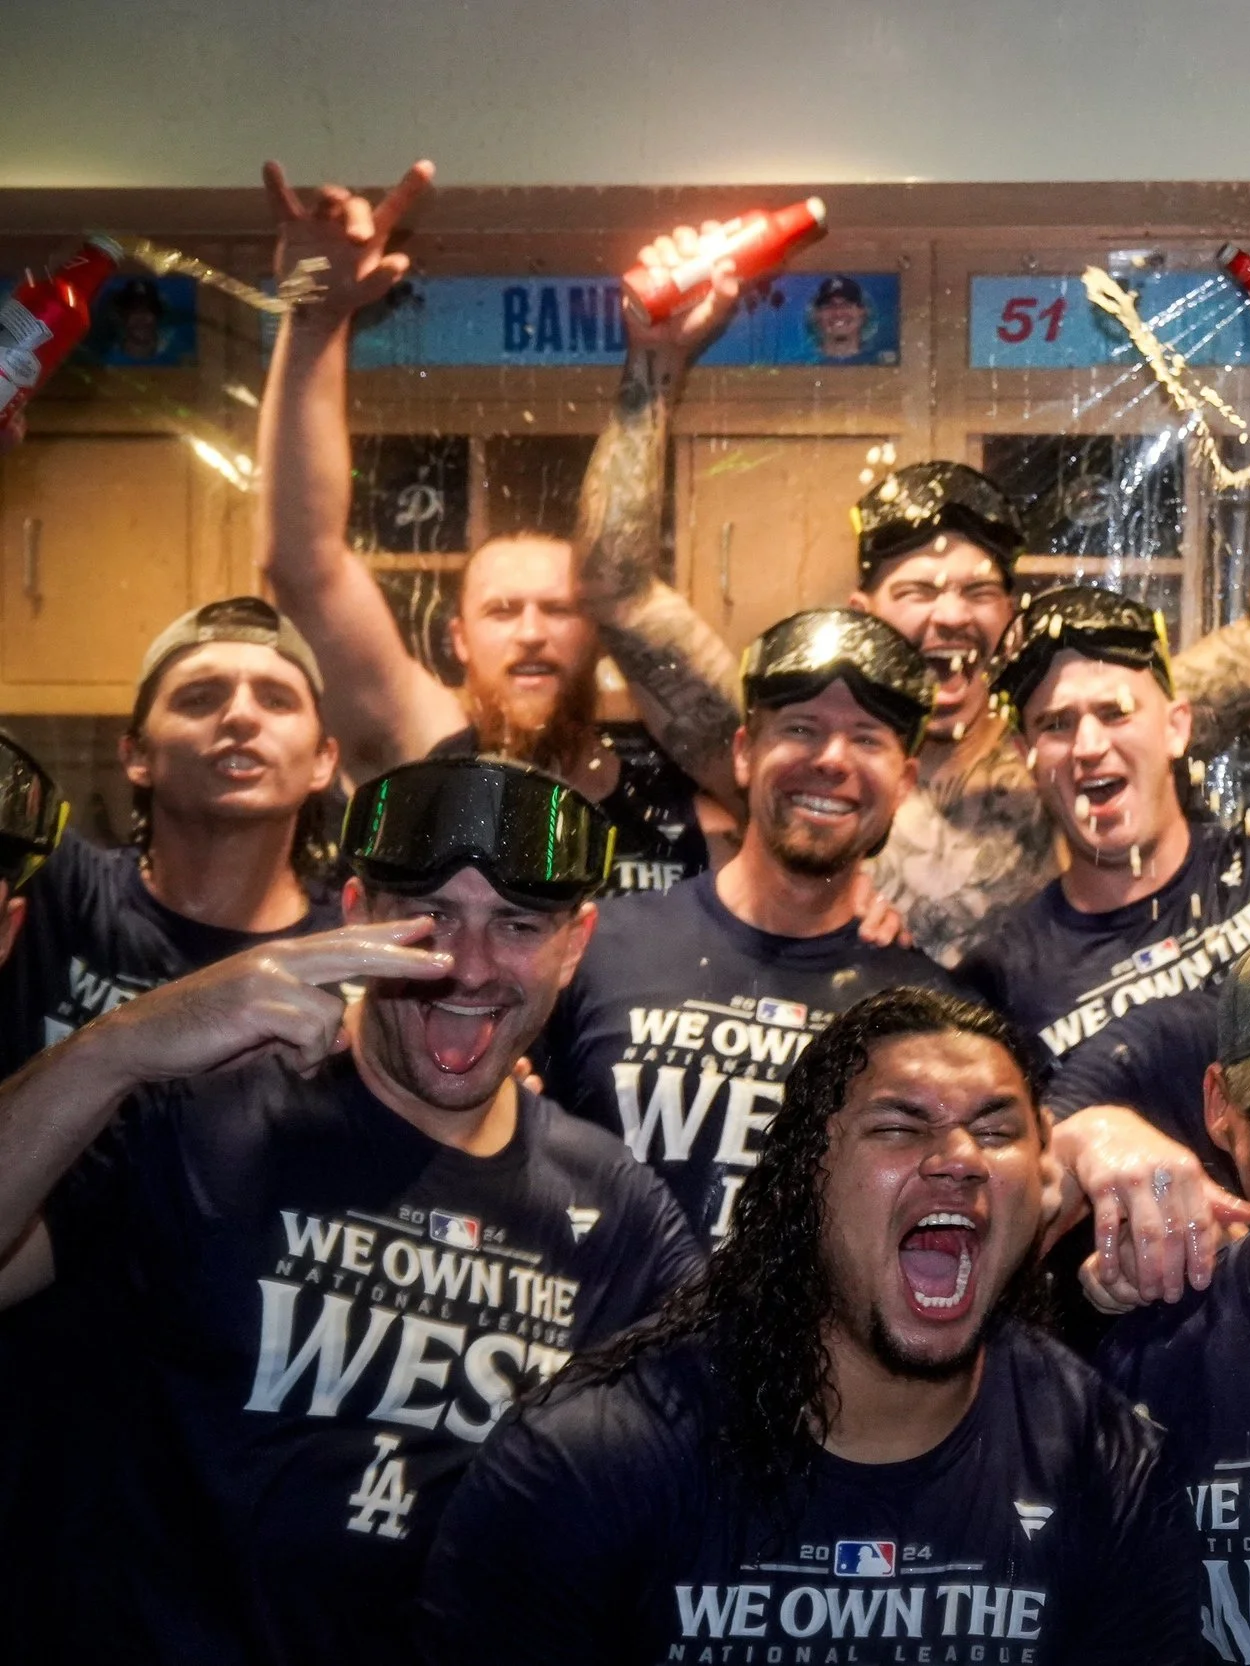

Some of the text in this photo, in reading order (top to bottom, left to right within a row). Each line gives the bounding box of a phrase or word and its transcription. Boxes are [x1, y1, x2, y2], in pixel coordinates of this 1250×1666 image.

[997, 297, 1068, 343] 51
[629, 1007, 709, 1050] WE
[1038, 996, 1107, 1056] WE
[400, 1206, 425, 1224] 20
[275, 1258, 451, 1320] NATIONAL
[280, 1210, 580, 1328] WE OWN THE
[347, 1434, 417, 1540] LA
[800, 1544, 932, 1561] 20 24
[675, 1585, 1046, 1641] WE OWN THE
[667, 1643, 1036, 1664] NATIONAL LEAGUE
